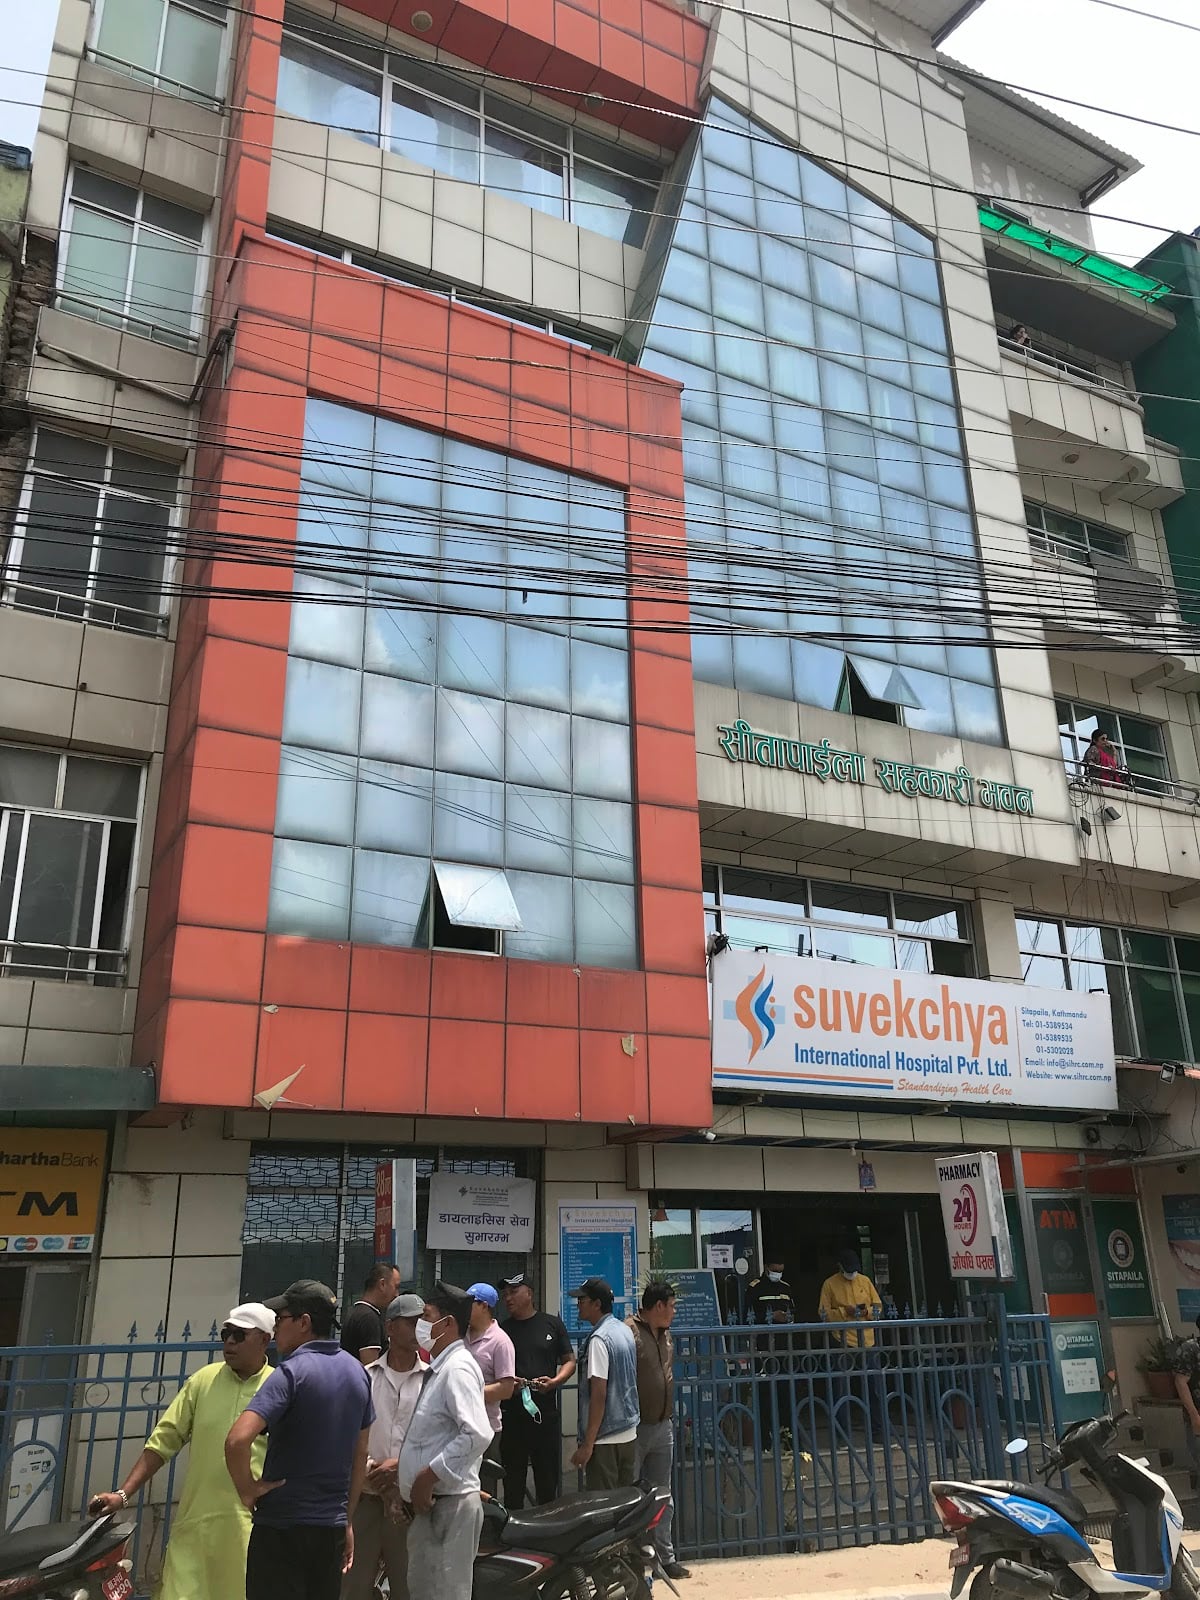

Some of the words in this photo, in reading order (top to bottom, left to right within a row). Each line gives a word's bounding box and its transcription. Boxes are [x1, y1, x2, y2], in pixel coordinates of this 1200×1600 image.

[718, 718, 866, 783] सीतापाईला
[874, 757, 975, 806] सहकारी
[978, 777, 1034, 816] भवन
[793, 979, 1009, 1057] suvekchya
[1052, 1009, 1087, 1019] Kathmandu
[1022, 1019, 1034, 1028] Tel:
[795, 1043, 890, 1069] International
[896, 1051, 952, 1076] Hospital
[957, 1056, 983, 1075] Pvt.
[988, 1058, 1012, 1077] Ltd.
[1025, 1058, 1045, 1066] Email:
[1026, 1070, 1054, 1079] Website:
[897, 1078, 958, 1097] Standardizing
[961, 1081, 990, 1096] Health
[992, 1084, 1012, 1096] Care
[939, 1162, 980, 1182] PHARMACY
[952, 1197, 972, 1222] 24
[438, 1212, 506, 1226] डायलाइसिस
[510, 1214, 530, 1227] सेवा
[953, 1222, 972, 1230] HOURS
[1040, 1209, 1078, 1230] ATM
[464, 1231, 510, 1244] सुभारम्भ
[1107, 1271, 1144, 1281] SITAPAILA
